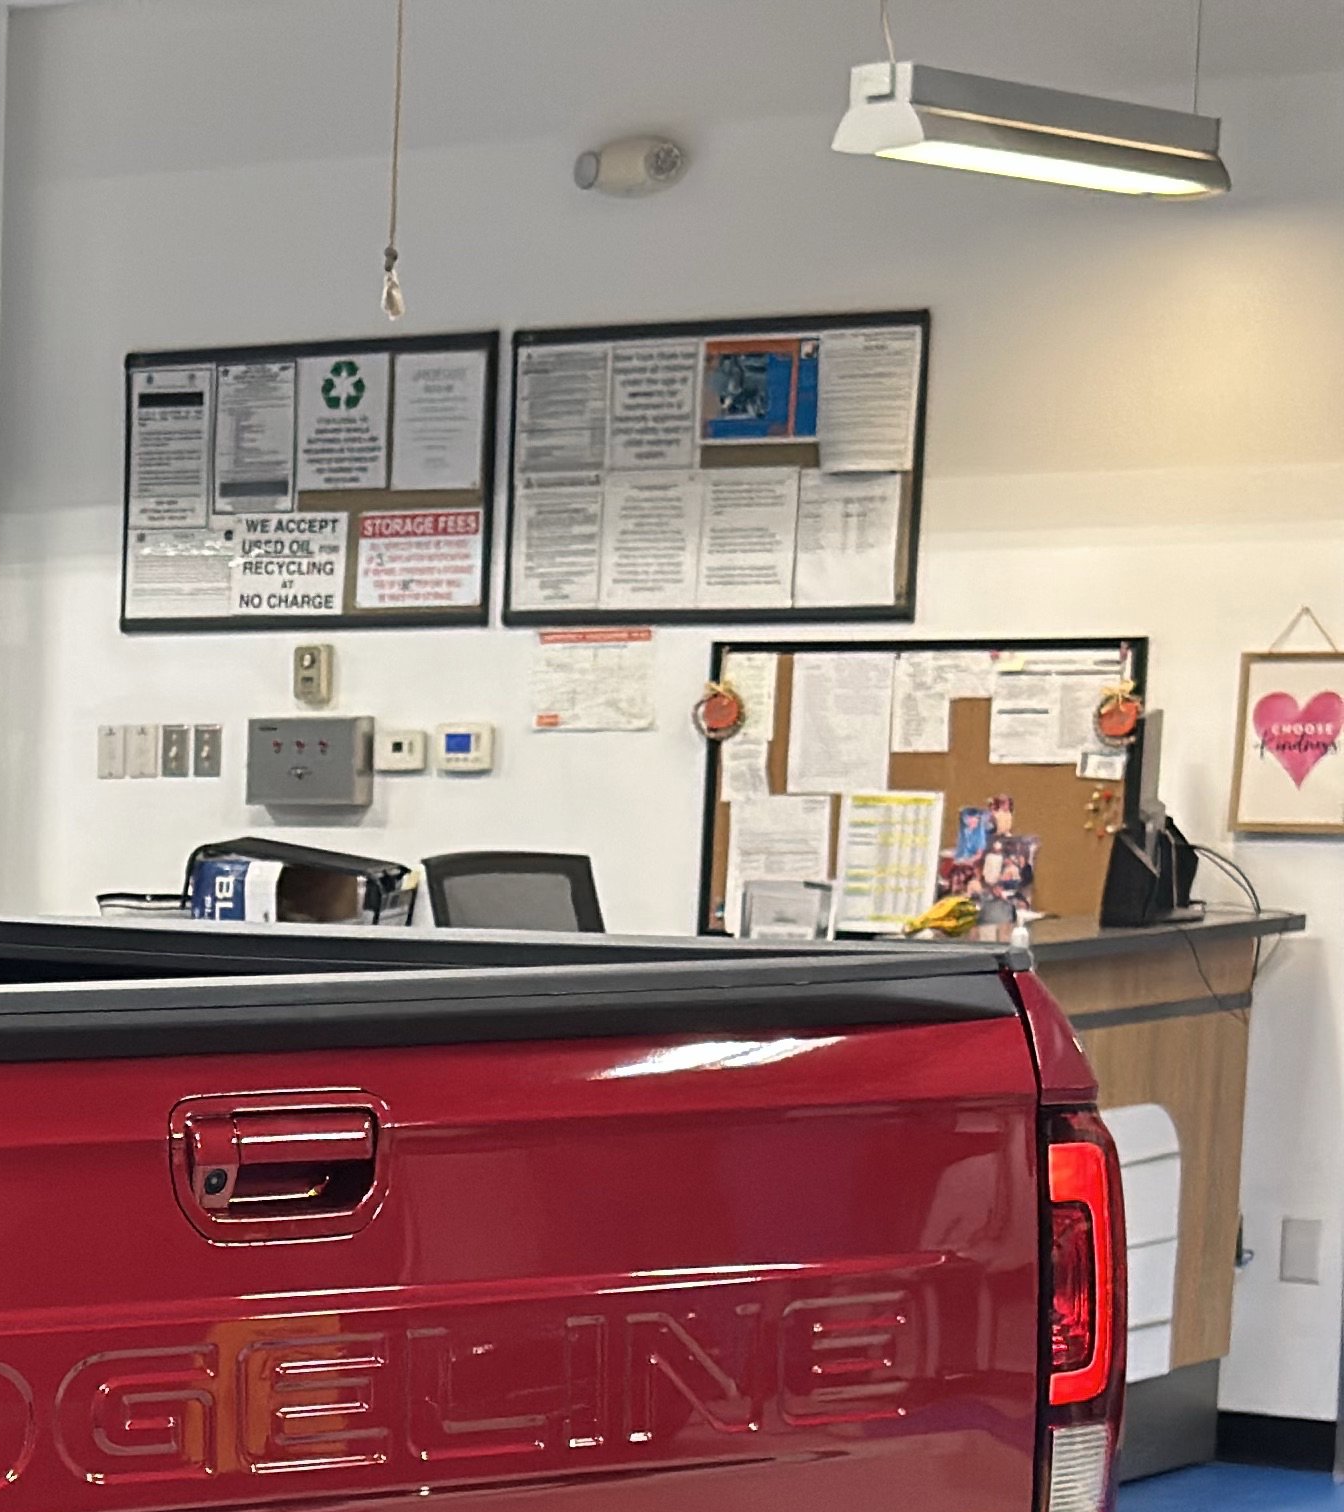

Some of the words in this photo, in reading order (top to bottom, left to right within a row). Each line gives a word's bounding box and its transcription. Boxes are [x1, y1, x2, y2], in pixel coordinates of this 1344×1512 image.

[245, 518, 270, 534] WE
[273, 518, 340, 534] ACCEPT
[362, 516, 434, 537] STORAGE
[437, 514, 477, 534] FEES
[241, 539, 285, 555] USED
[288, 539, 313, 555] OIL
[242, 560, 335, 577] RECYCLING
[238, 594, 263, 609] NO
[267, 593, 334, 609] CHARGE
[1271, 722, 1334, 736] CHOOSE
